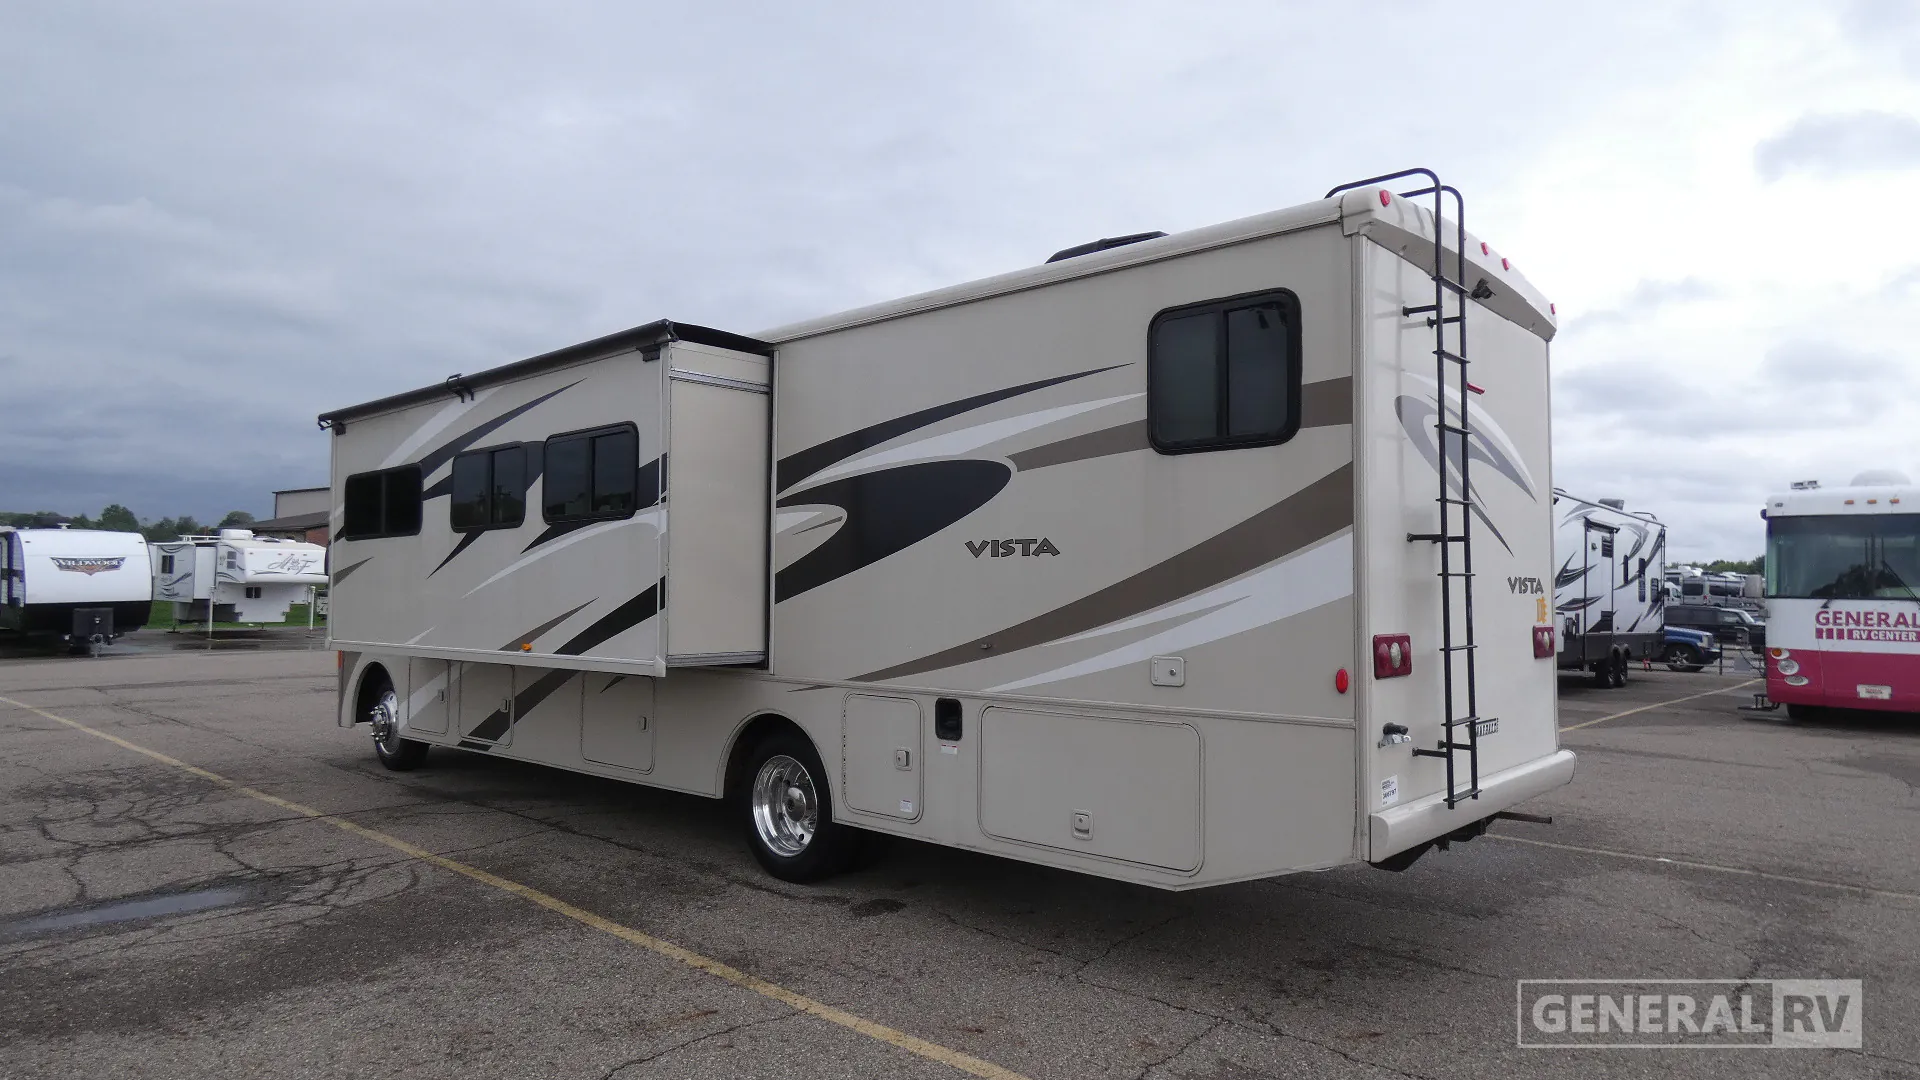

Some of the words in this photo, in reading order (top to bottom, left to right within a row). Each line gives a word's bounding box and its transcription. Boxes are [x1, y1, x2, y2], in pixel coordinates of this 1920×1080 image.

[964, 537, 1060, 559] VISTA
[1507, 576, 1544, 595] VISTA
[1815, 610, 1920, 629] GENERAL
[1852, 630, 1870, 641] RV
[1870, 630, 1917, 641] CENTER
